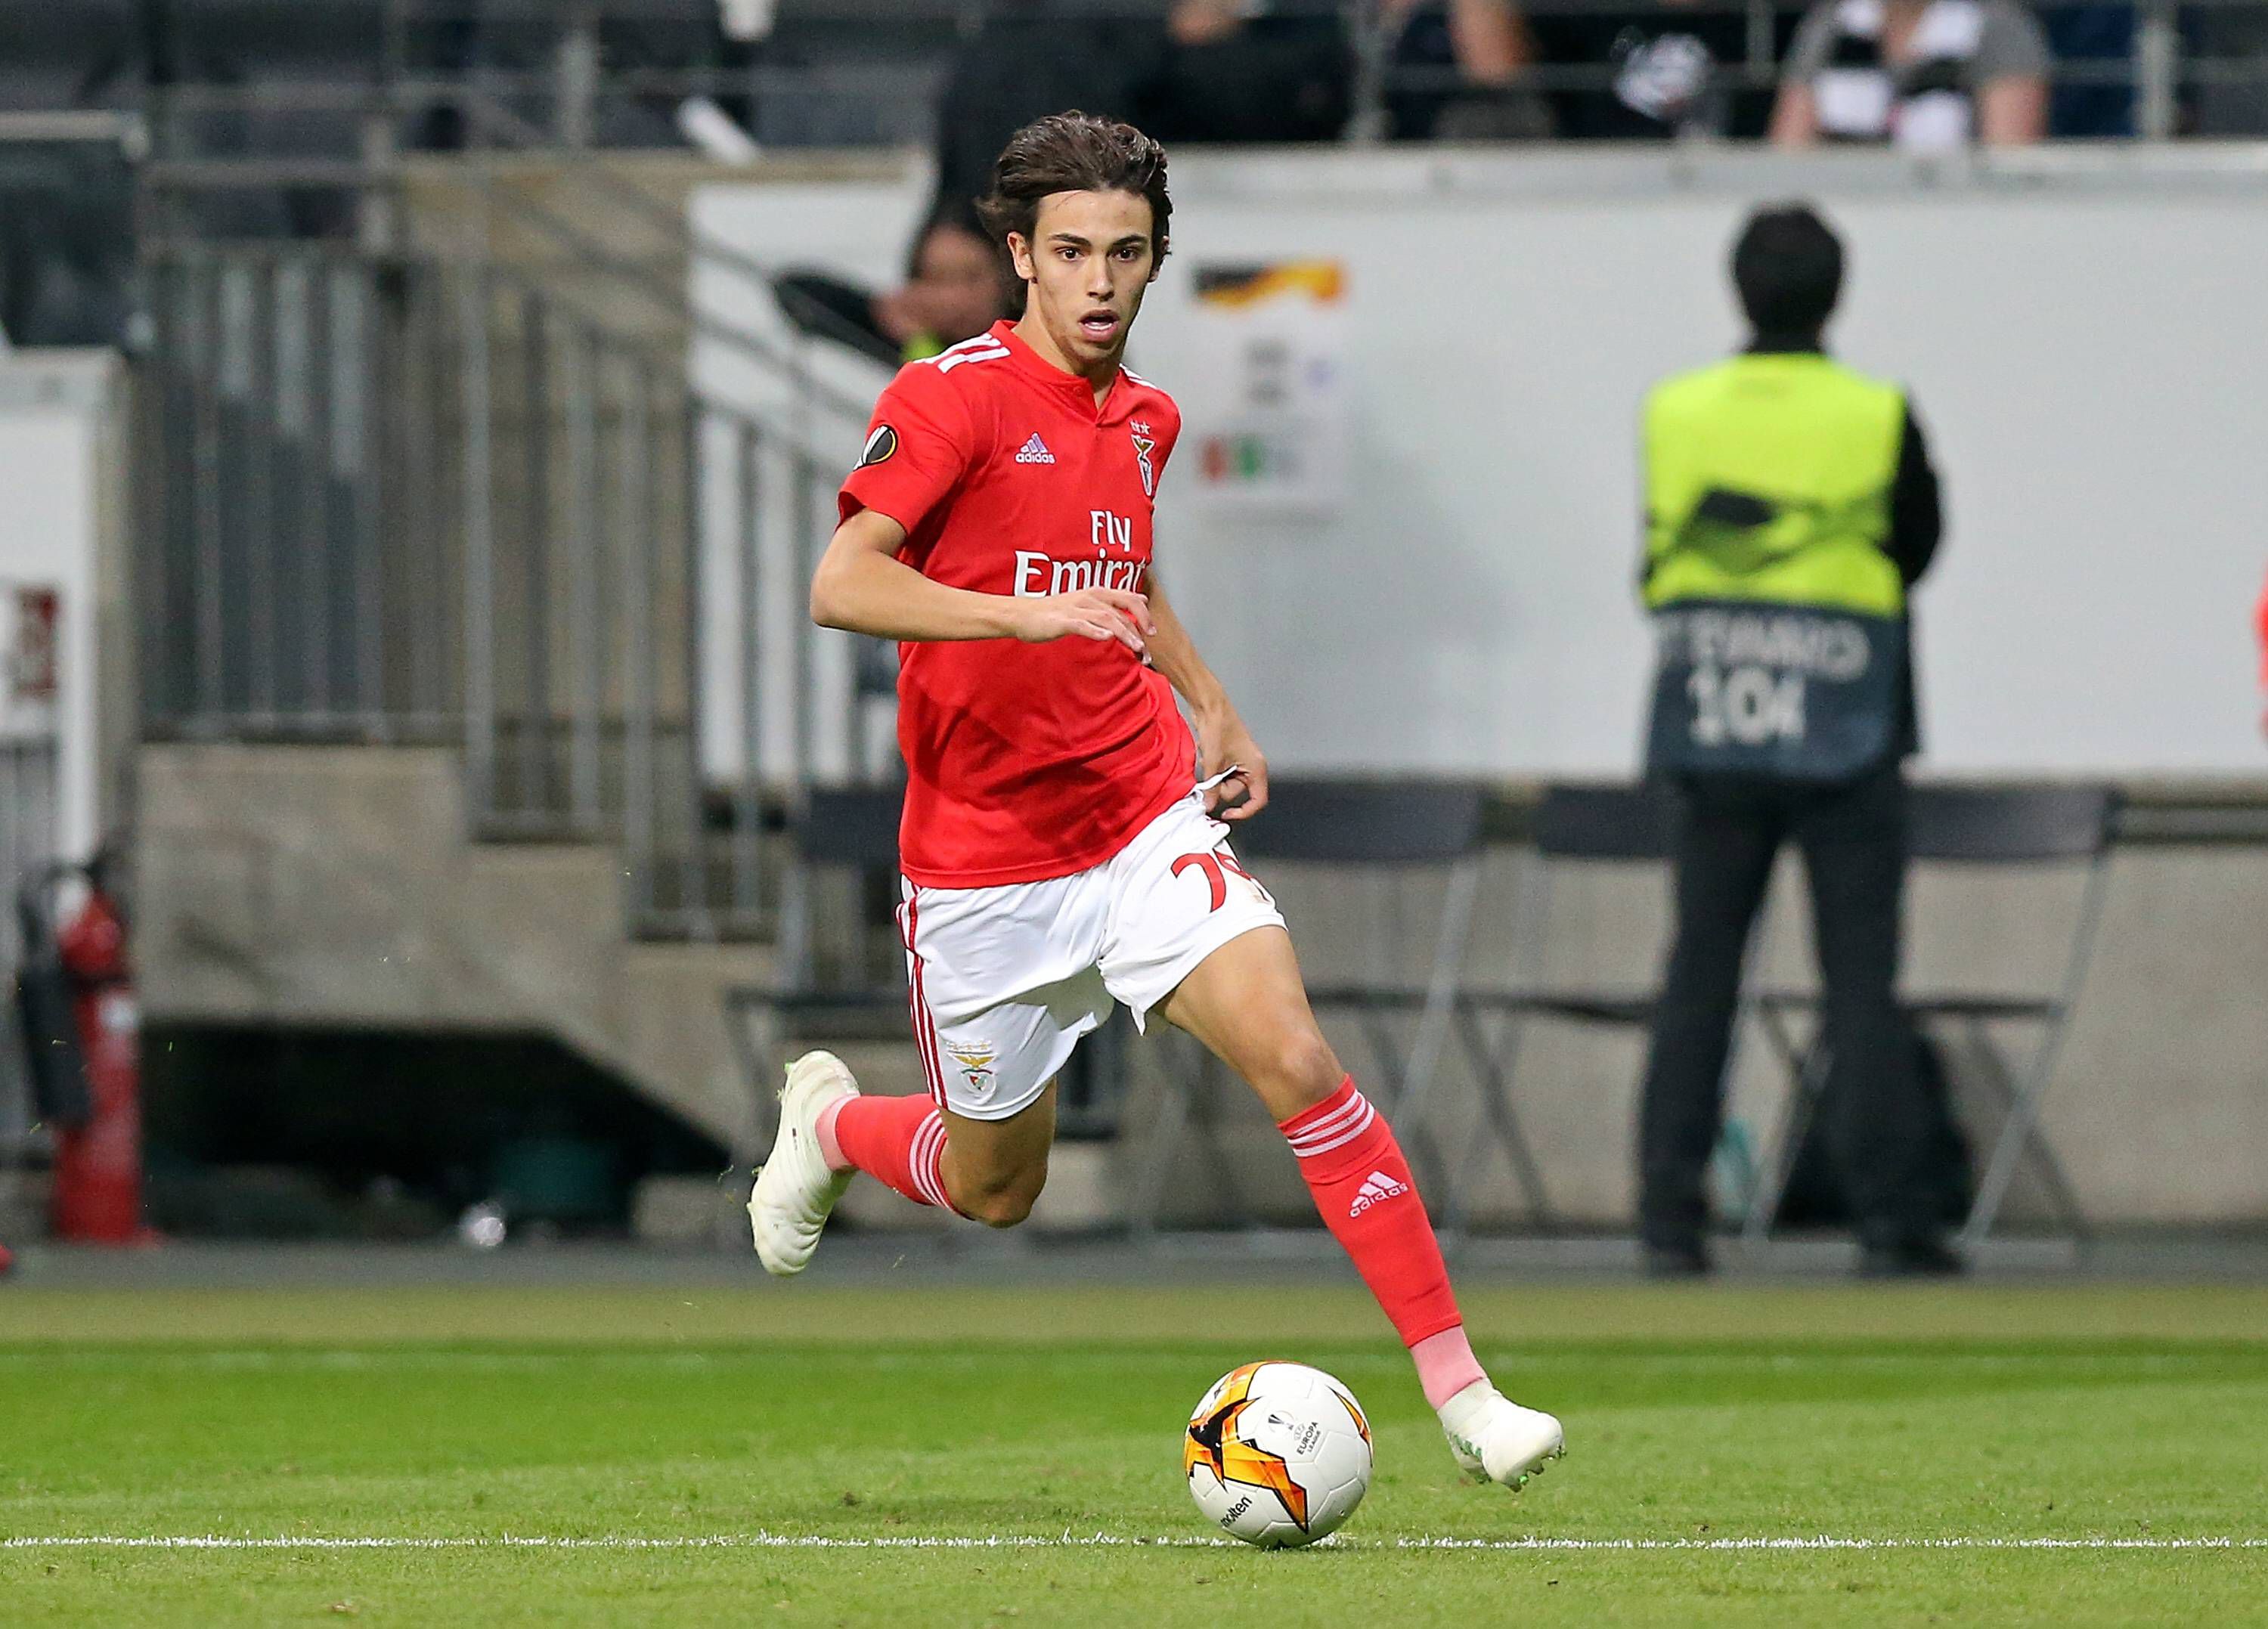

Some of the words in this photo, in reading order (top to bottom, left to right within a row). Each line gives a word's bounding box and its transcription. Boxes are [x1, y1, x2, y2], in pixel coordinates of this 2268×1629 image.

[1015, 452, 1055, 464] adidas
[1089, 509, 1131, 553] Fly
[1349, 1182, 1408, 1218] adidas
[1297, 1422, 1318, 1455] EUROPA
[1220, 1497, 1253, 1528] molten
